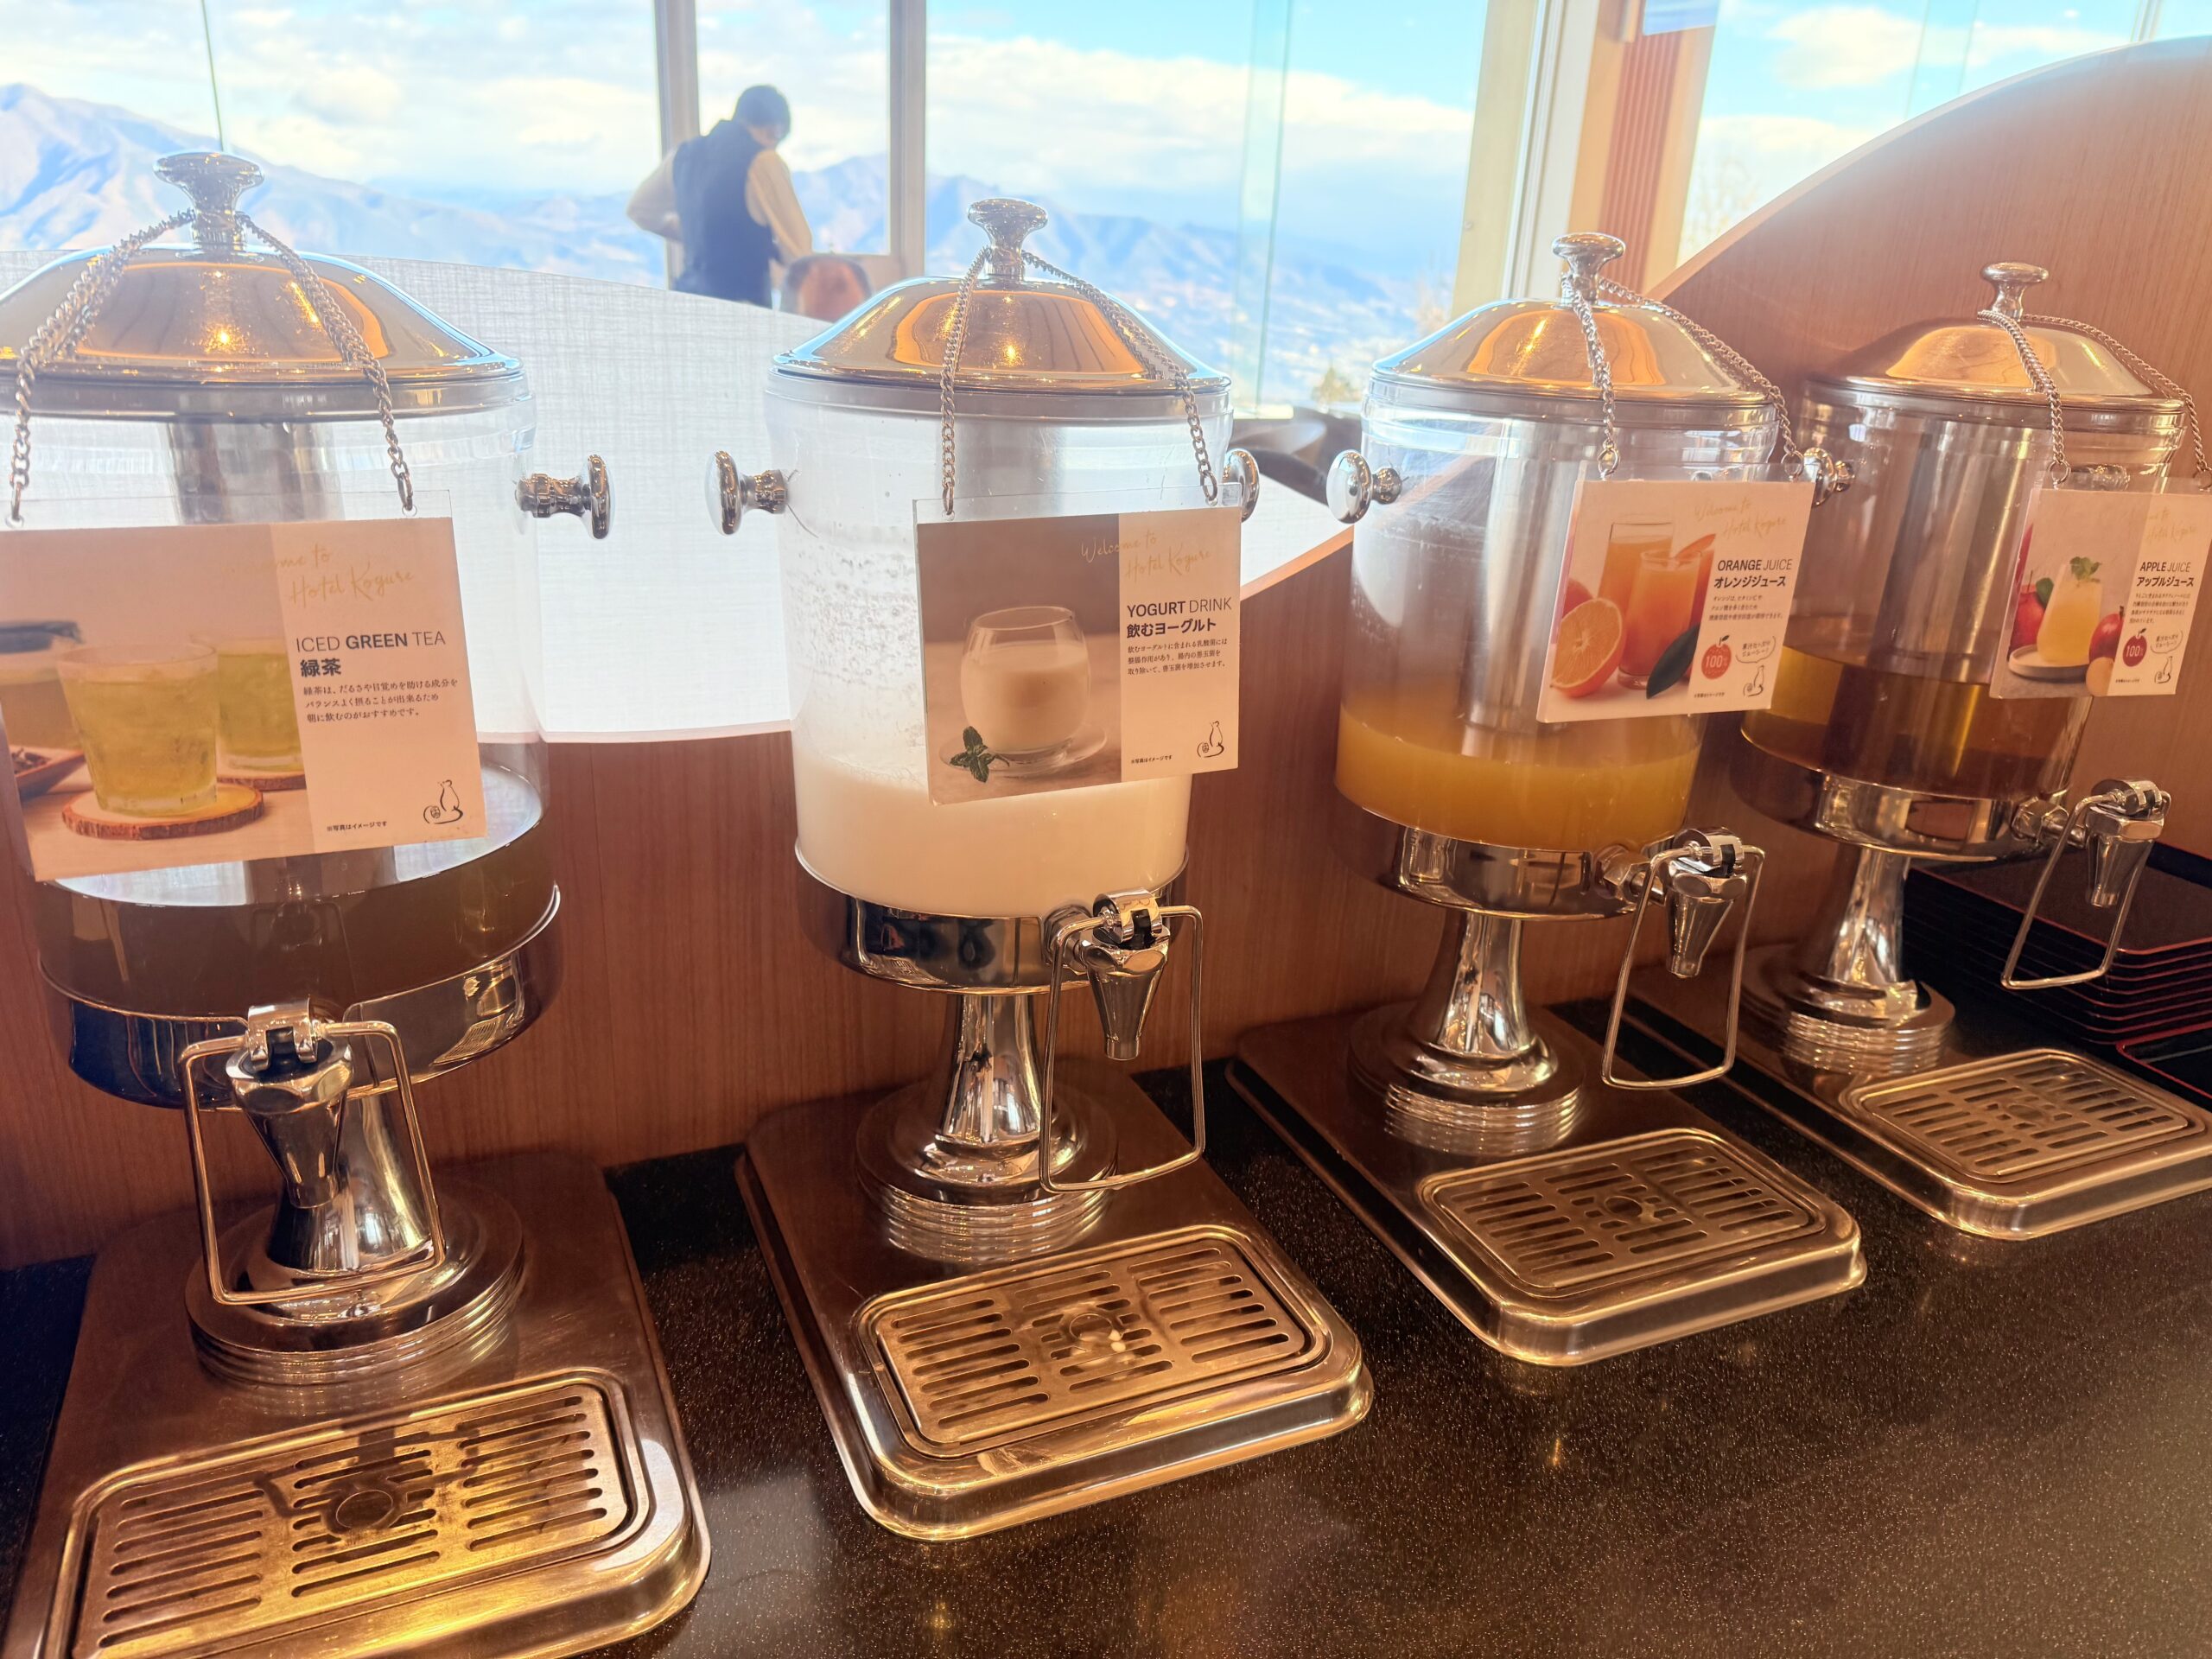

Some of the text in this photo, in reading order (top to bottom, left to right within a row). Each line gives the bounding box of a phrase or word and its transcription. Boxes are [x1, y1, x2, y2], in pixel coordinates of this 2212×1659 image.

[1125, 553, 1164, 583] Hotel
[1717, 558, 1793, 571] ORANGE JUICE
[2139, 562, 2191, 572] APPLE JUICE
[289, 574, 346, 609] Hotel
[350, 560, 415, 602] Kogure
[1713, 575, 1787, 588] オレンジジュース
[2136, 576, 2194, 588] アップルジュース
[1127, 596, 1232, 619] YOGURT DRINK
[1126, 618, 1217, 639] 飲むヨーグルト
[296, 631, 446, 653] ICED GREEN TEA
[300, 658, 342, 677] 緑茶
[307, 708, 420, 723] 朝に飲むのがおすすめです。
